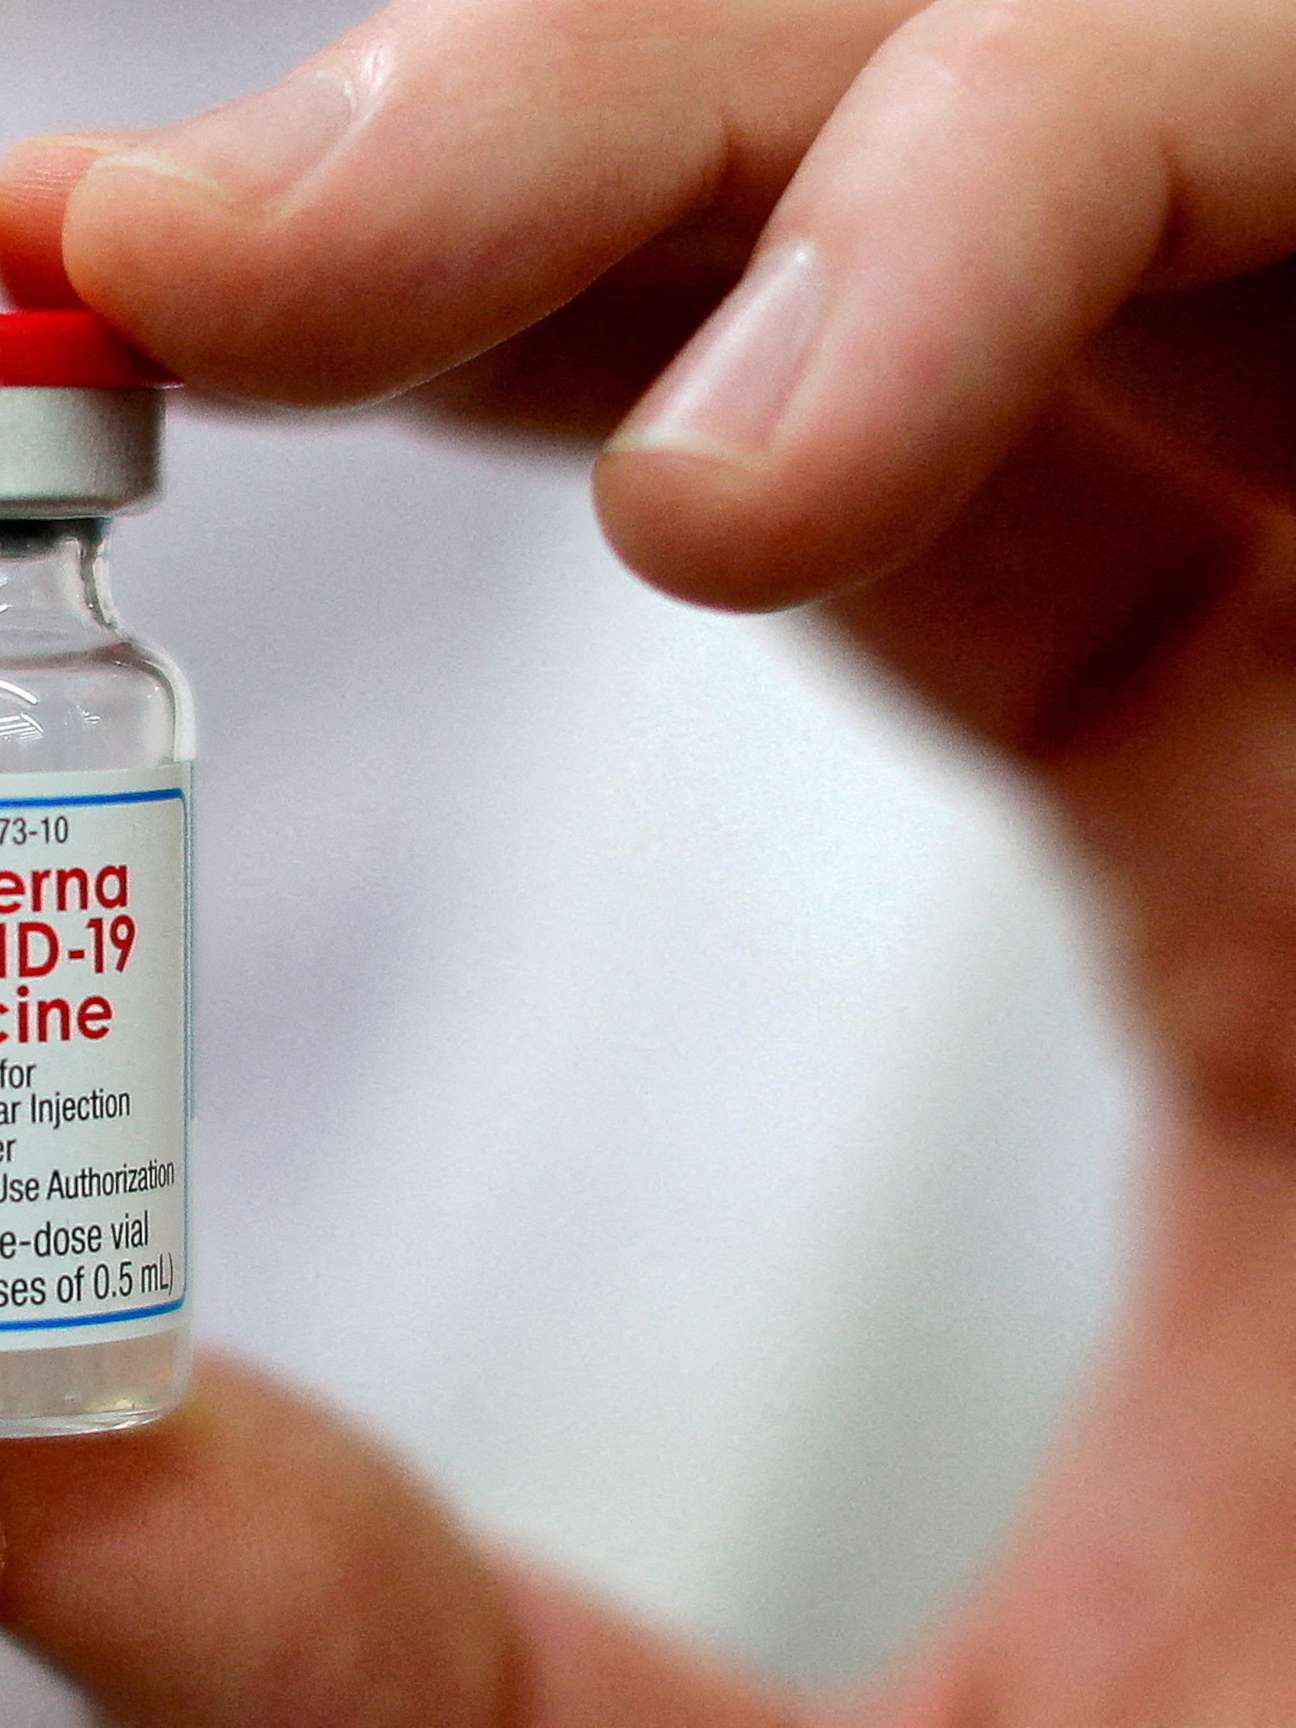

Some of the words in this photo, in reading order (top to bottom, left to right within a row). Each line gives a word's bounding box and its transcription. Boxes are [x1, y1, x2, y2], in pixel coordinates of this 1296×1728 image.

[31, 1090, 130, 1128] Injection
[47, 1160, 175, 1199] Authorization
[111, 1211, 149, 1249] vial
[57, 1274, 84, 1303] of
[93, 1264, 132, 1299] 0.5
[141, 1255, 174, 1295] mL)
